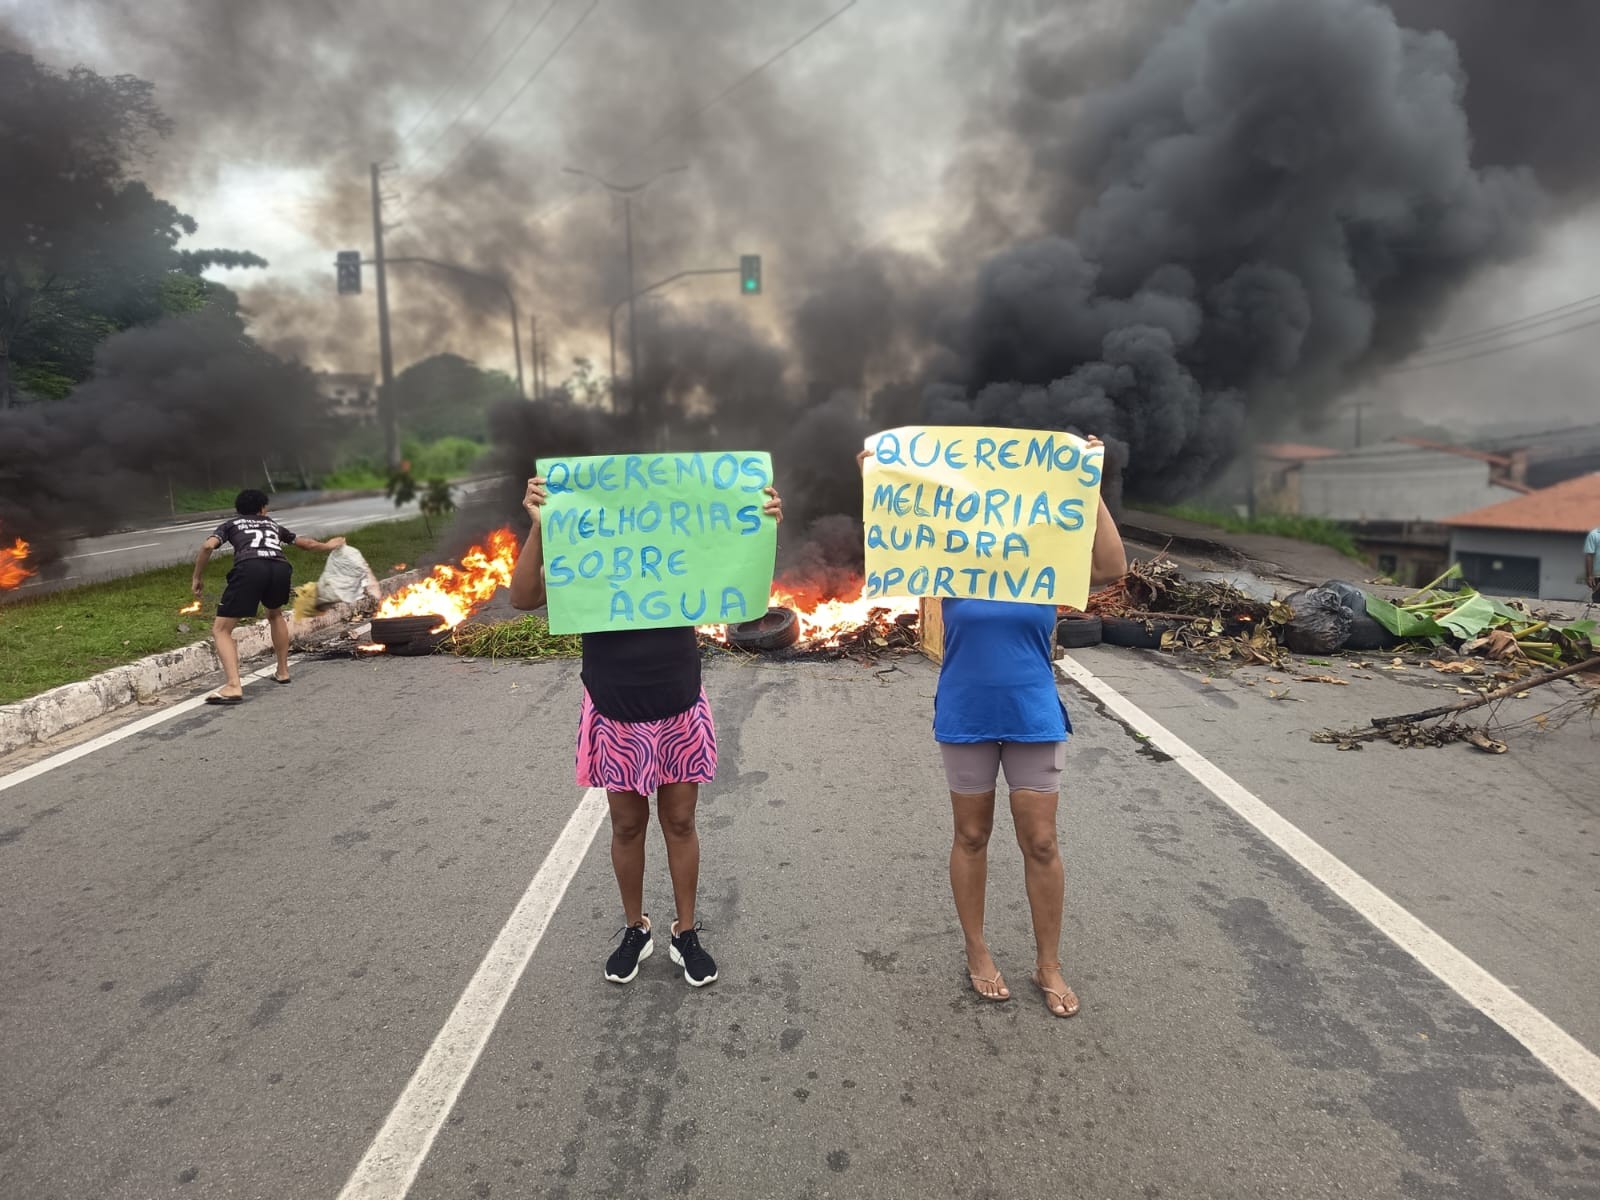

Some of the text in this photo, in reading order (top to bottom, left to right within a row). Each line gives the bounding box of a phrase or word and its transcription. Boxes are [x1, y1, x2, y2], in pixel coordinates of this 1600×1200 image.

[546, 453, 768, 494] QUEREMOS
[876, 432, 1102, 487] QUEREMOS
[547, 501, 761, 545] MELHORIAS
[871, 482, 1085, 531] MELHORIAS
[244, 529, 282, 550] 72
[867, 524, 1029, 560] QUADRA
[547, 546, 688, 587] SOBRE
[867, 566, 1056, 599] SPORTIVA
